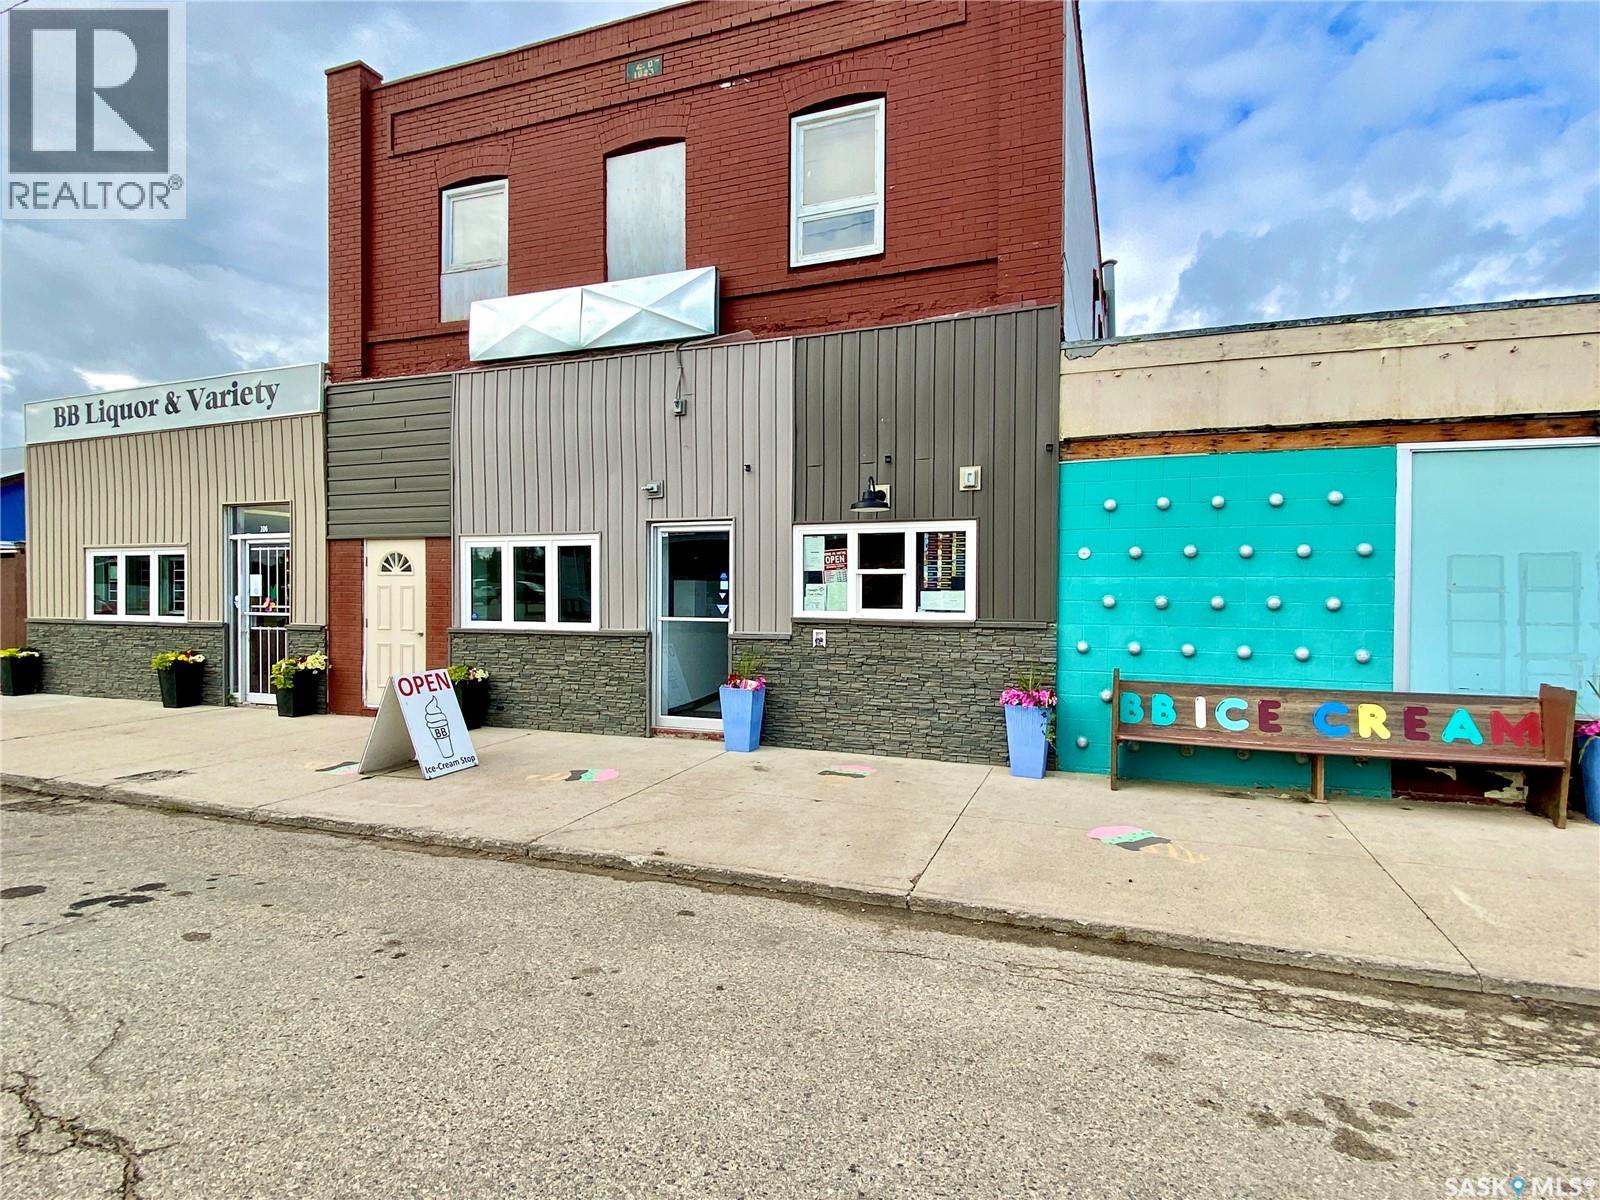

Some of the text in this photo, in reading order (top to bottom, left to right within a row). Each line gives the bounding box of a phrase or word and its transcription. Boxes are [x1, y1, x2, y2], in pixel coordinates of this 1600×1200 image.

[53, 380, 281, 428] BB Liquor & Variety
[825, 555, 845, 564] OPEN
[397, 672, 451, 697] OPEN
[434, 727, 448, 738] BB
[1195, 696, 1283, 734] ICE
[1312, 702, 1543, 748] CREAM
[424, 754, 476, 774] Ice-Cream Stop
